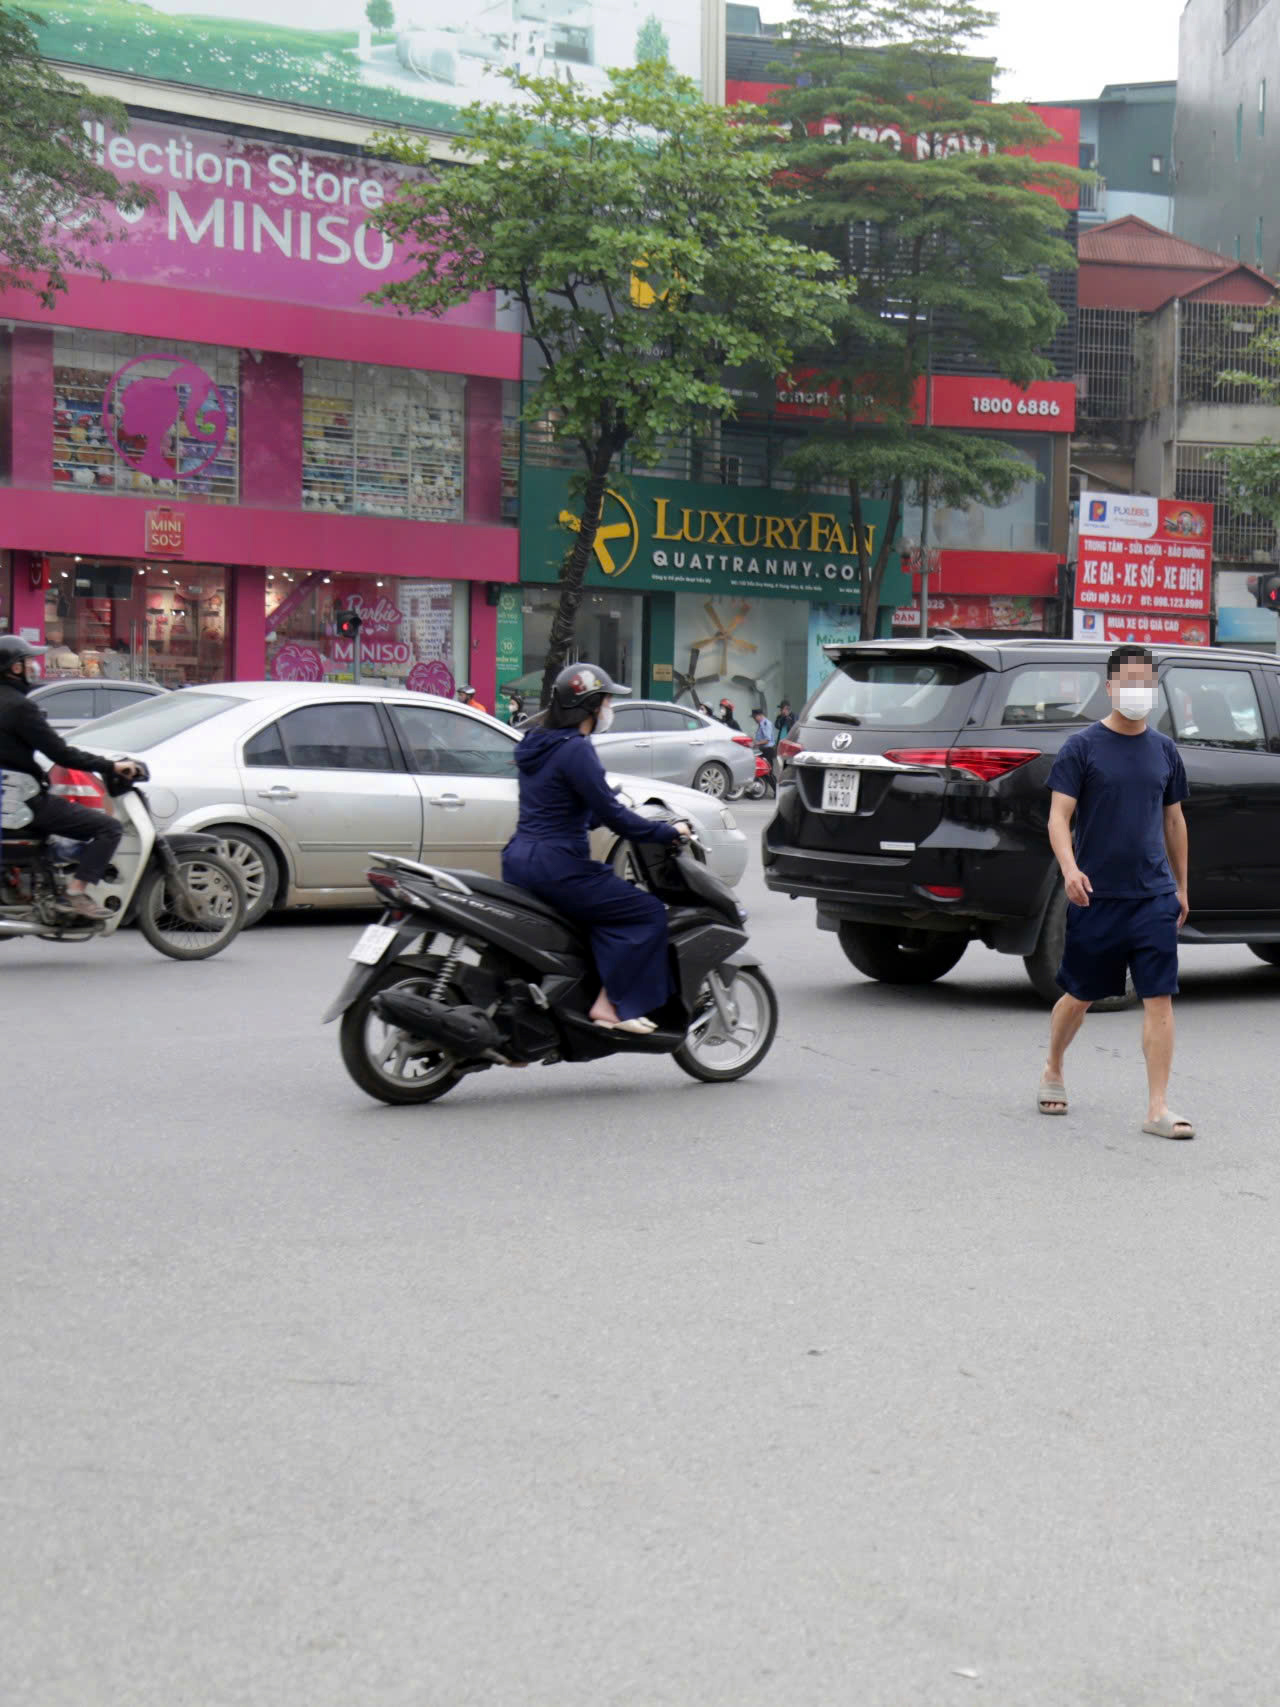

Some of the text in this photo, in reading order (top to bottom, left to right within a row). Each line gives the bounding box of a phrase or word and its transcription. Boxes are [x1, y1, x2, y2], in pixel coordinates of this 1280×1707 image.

[80, 119, 385, 209] llection Store
[167, 191, 394, 270] MINISO
[973, 397, 1060, 416] 1800 6886
[151, 519, 181, 532] MINI
[653, 550, 873, 581] QUATTRANMY.CO
[1083, 560, 1098, 585] XE
[1100, 561, 1114, 585] GA
[1124, 562, 1138, 587] XE
[1140, 557, 1155, 588] SỐ
[1164, 565, 1177, 590] XE
[1107, 617, 1125, 630] MUA
[1127, 618, 1137, 630] XE
[1164, 620, 1179, 632] CAO
[334, 642, 408, 662] MNISO
